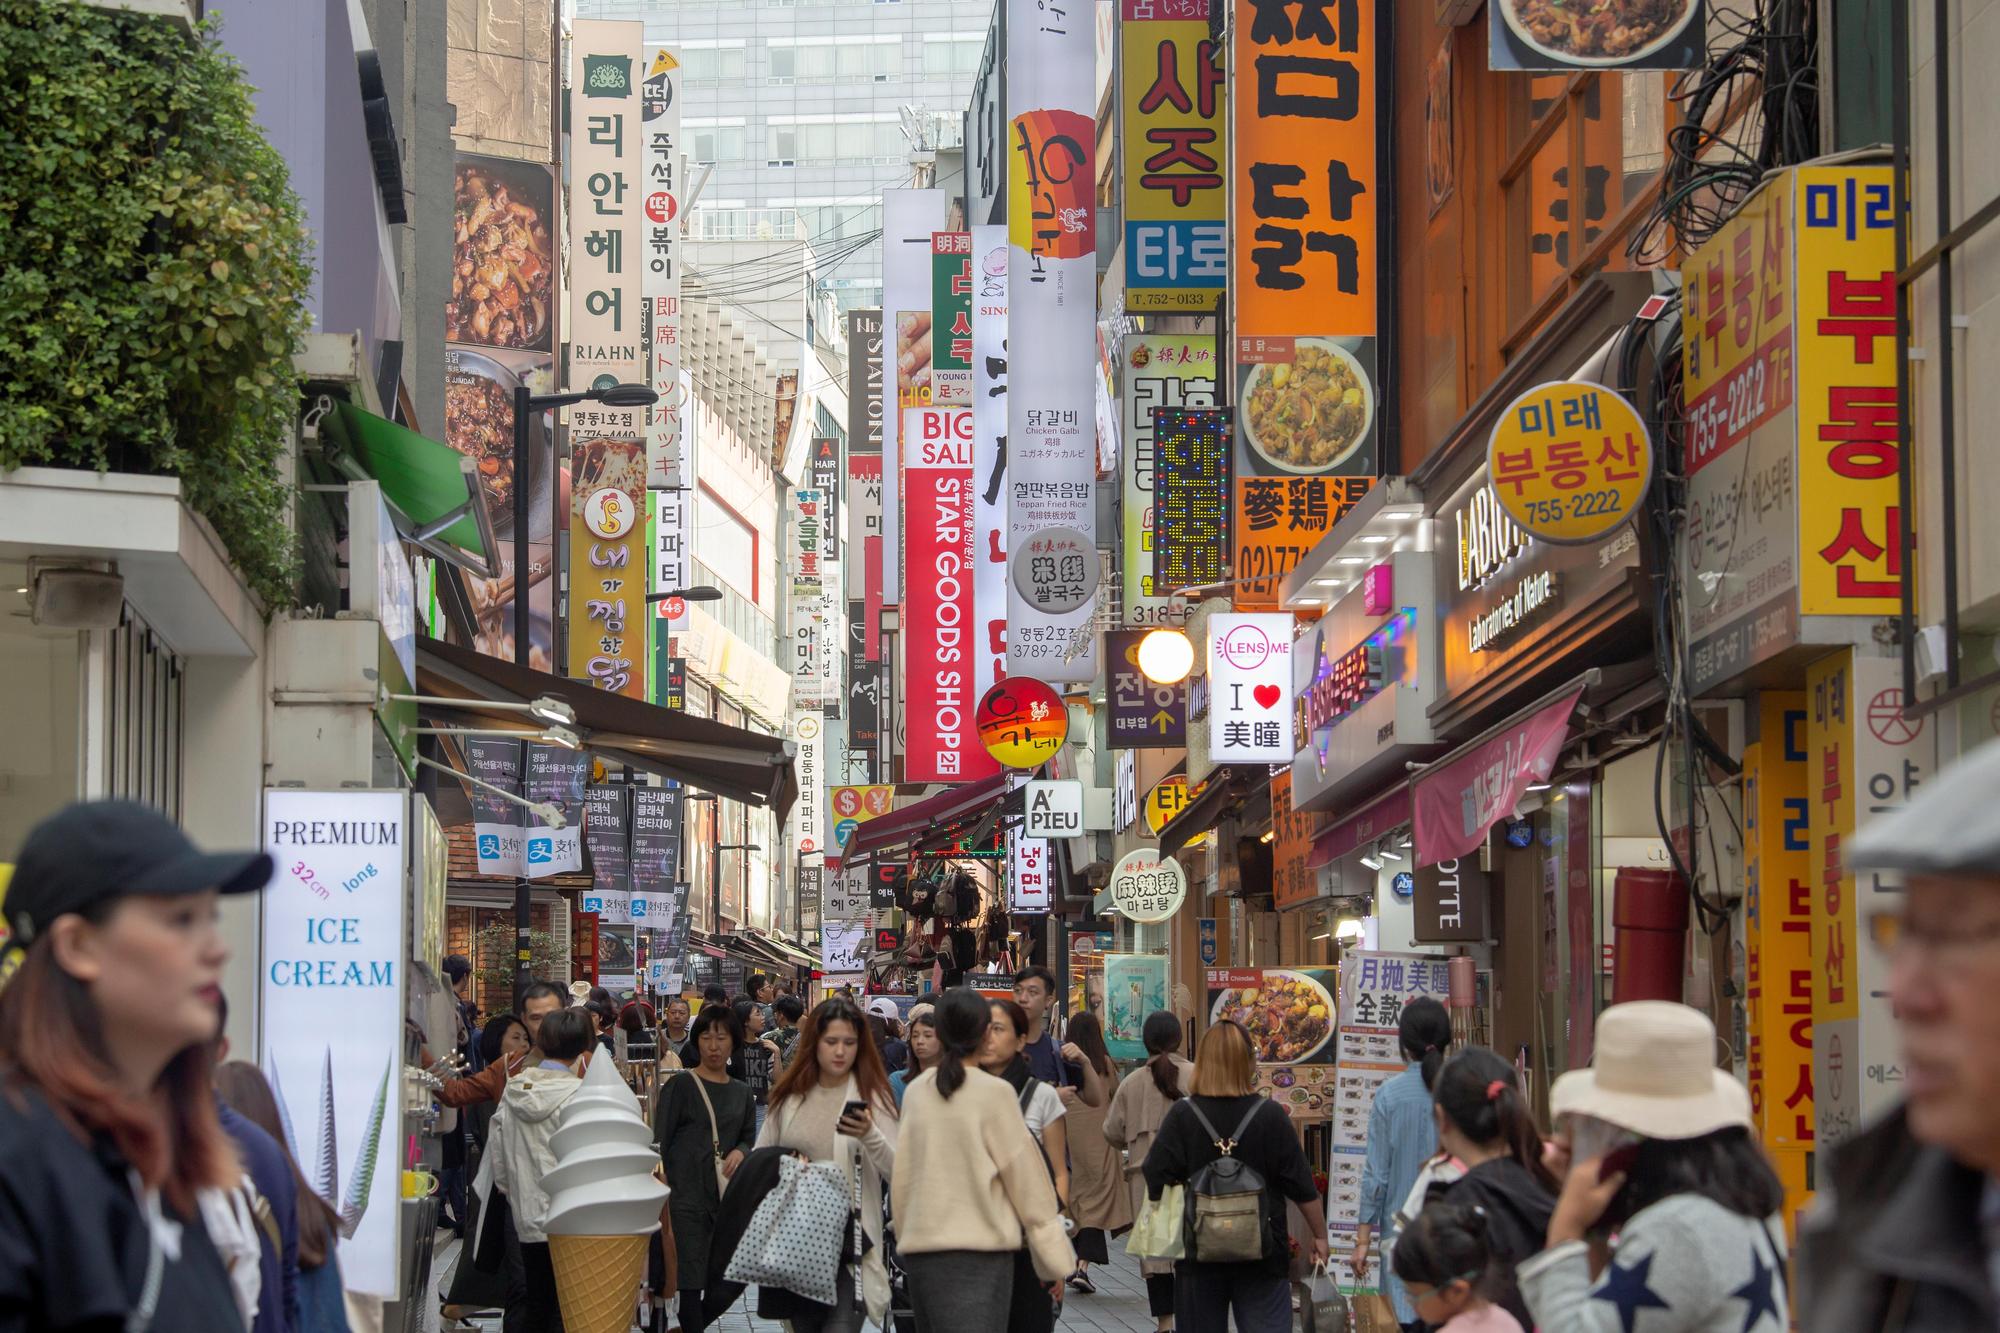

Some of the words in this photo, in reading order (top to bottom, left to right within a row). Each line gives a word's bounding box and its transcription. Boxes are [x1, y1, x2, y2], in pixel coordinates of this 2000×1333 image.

[1138, 40, 1226, 207] 사주
[650, 133, 673, 280] 즉석떡볶이
[584, 114, 628, 332] 리안헤어
[937, 236, 972, 252] 明洞
[1136, 225, 1226, 280] 타로
[1706, 196, 1786, 369] 부동산
[1133, 294, 1204, 305] T.752-0133
[576, 345, 635, 360] RIAHN
[654, 298, 678, 476] 即席トッポッキ
[574, 412, 632, 428] 명동1호점
[1028, 410, 1078, 426] 닭갈비
[1519, 392, 1602, 437] 미래
[1690, 359, 1766, 462] 755-2222
[1026, 427, 1057, 435] Chicken
[1060, 427, 1080, 435] Galbi
[1818, 270, 1901, 598] 부동산
[815, 460, 836, 468] HAIR
[1495, 432, 1641, 497] 부동산
[1014, 482, 1090, 499] 철판볶음밥
[1016, 501, 1044, 509] Teppan
[1047, 500, 1067, 508] Fried
[936, 478, 960, 542] STAR
[1525, 489, 1622, 525] 755-2222
[936, 551, 960, 662] GOODS
[1035, 584, 1085, 603] 쌀국수
[1468, 595, 1512, 654] Laboratories
[1514, 581, 1524, 620] of
[1524, 570, 1550, 614] Nature
[797, 626, 816, 676] 아미소
[1014, 644, 1088, 658] 3789-22
[1229, 642, 1265, 654] LENS
[1271, 642, 1289, 654] ME
[936, 671, 960, 749] SHOP
[1230, 684, 1244, 711] I
[1116, 717, 1148, 730] 대부업
[1224, 720, 1280, 748] 美瞳
[941, 754, 956, 773] 2F
[802, 744, 814, 835] 명동파티파티
[273, 821, 399, 846] PREMIUM
[636, 818, 672, 830] 판타지아
[1031, 812, 1078, 830] PIEU
[292, 861, 330, 900] 32cm
[342, 862, 378, 894] long
[1020, 847, 1042, 895] 냉면
[1128, 897, 1169, 913] 마라탕
[306, 918, 361, 944] ICE
[270, 960, 395, 988] CREAM
[1358, 958, 1449, 994] 月抛美瞳
[1355, 992, 1401, 1026] 全款
[1867, 1064, 1903, 1084] 에스
